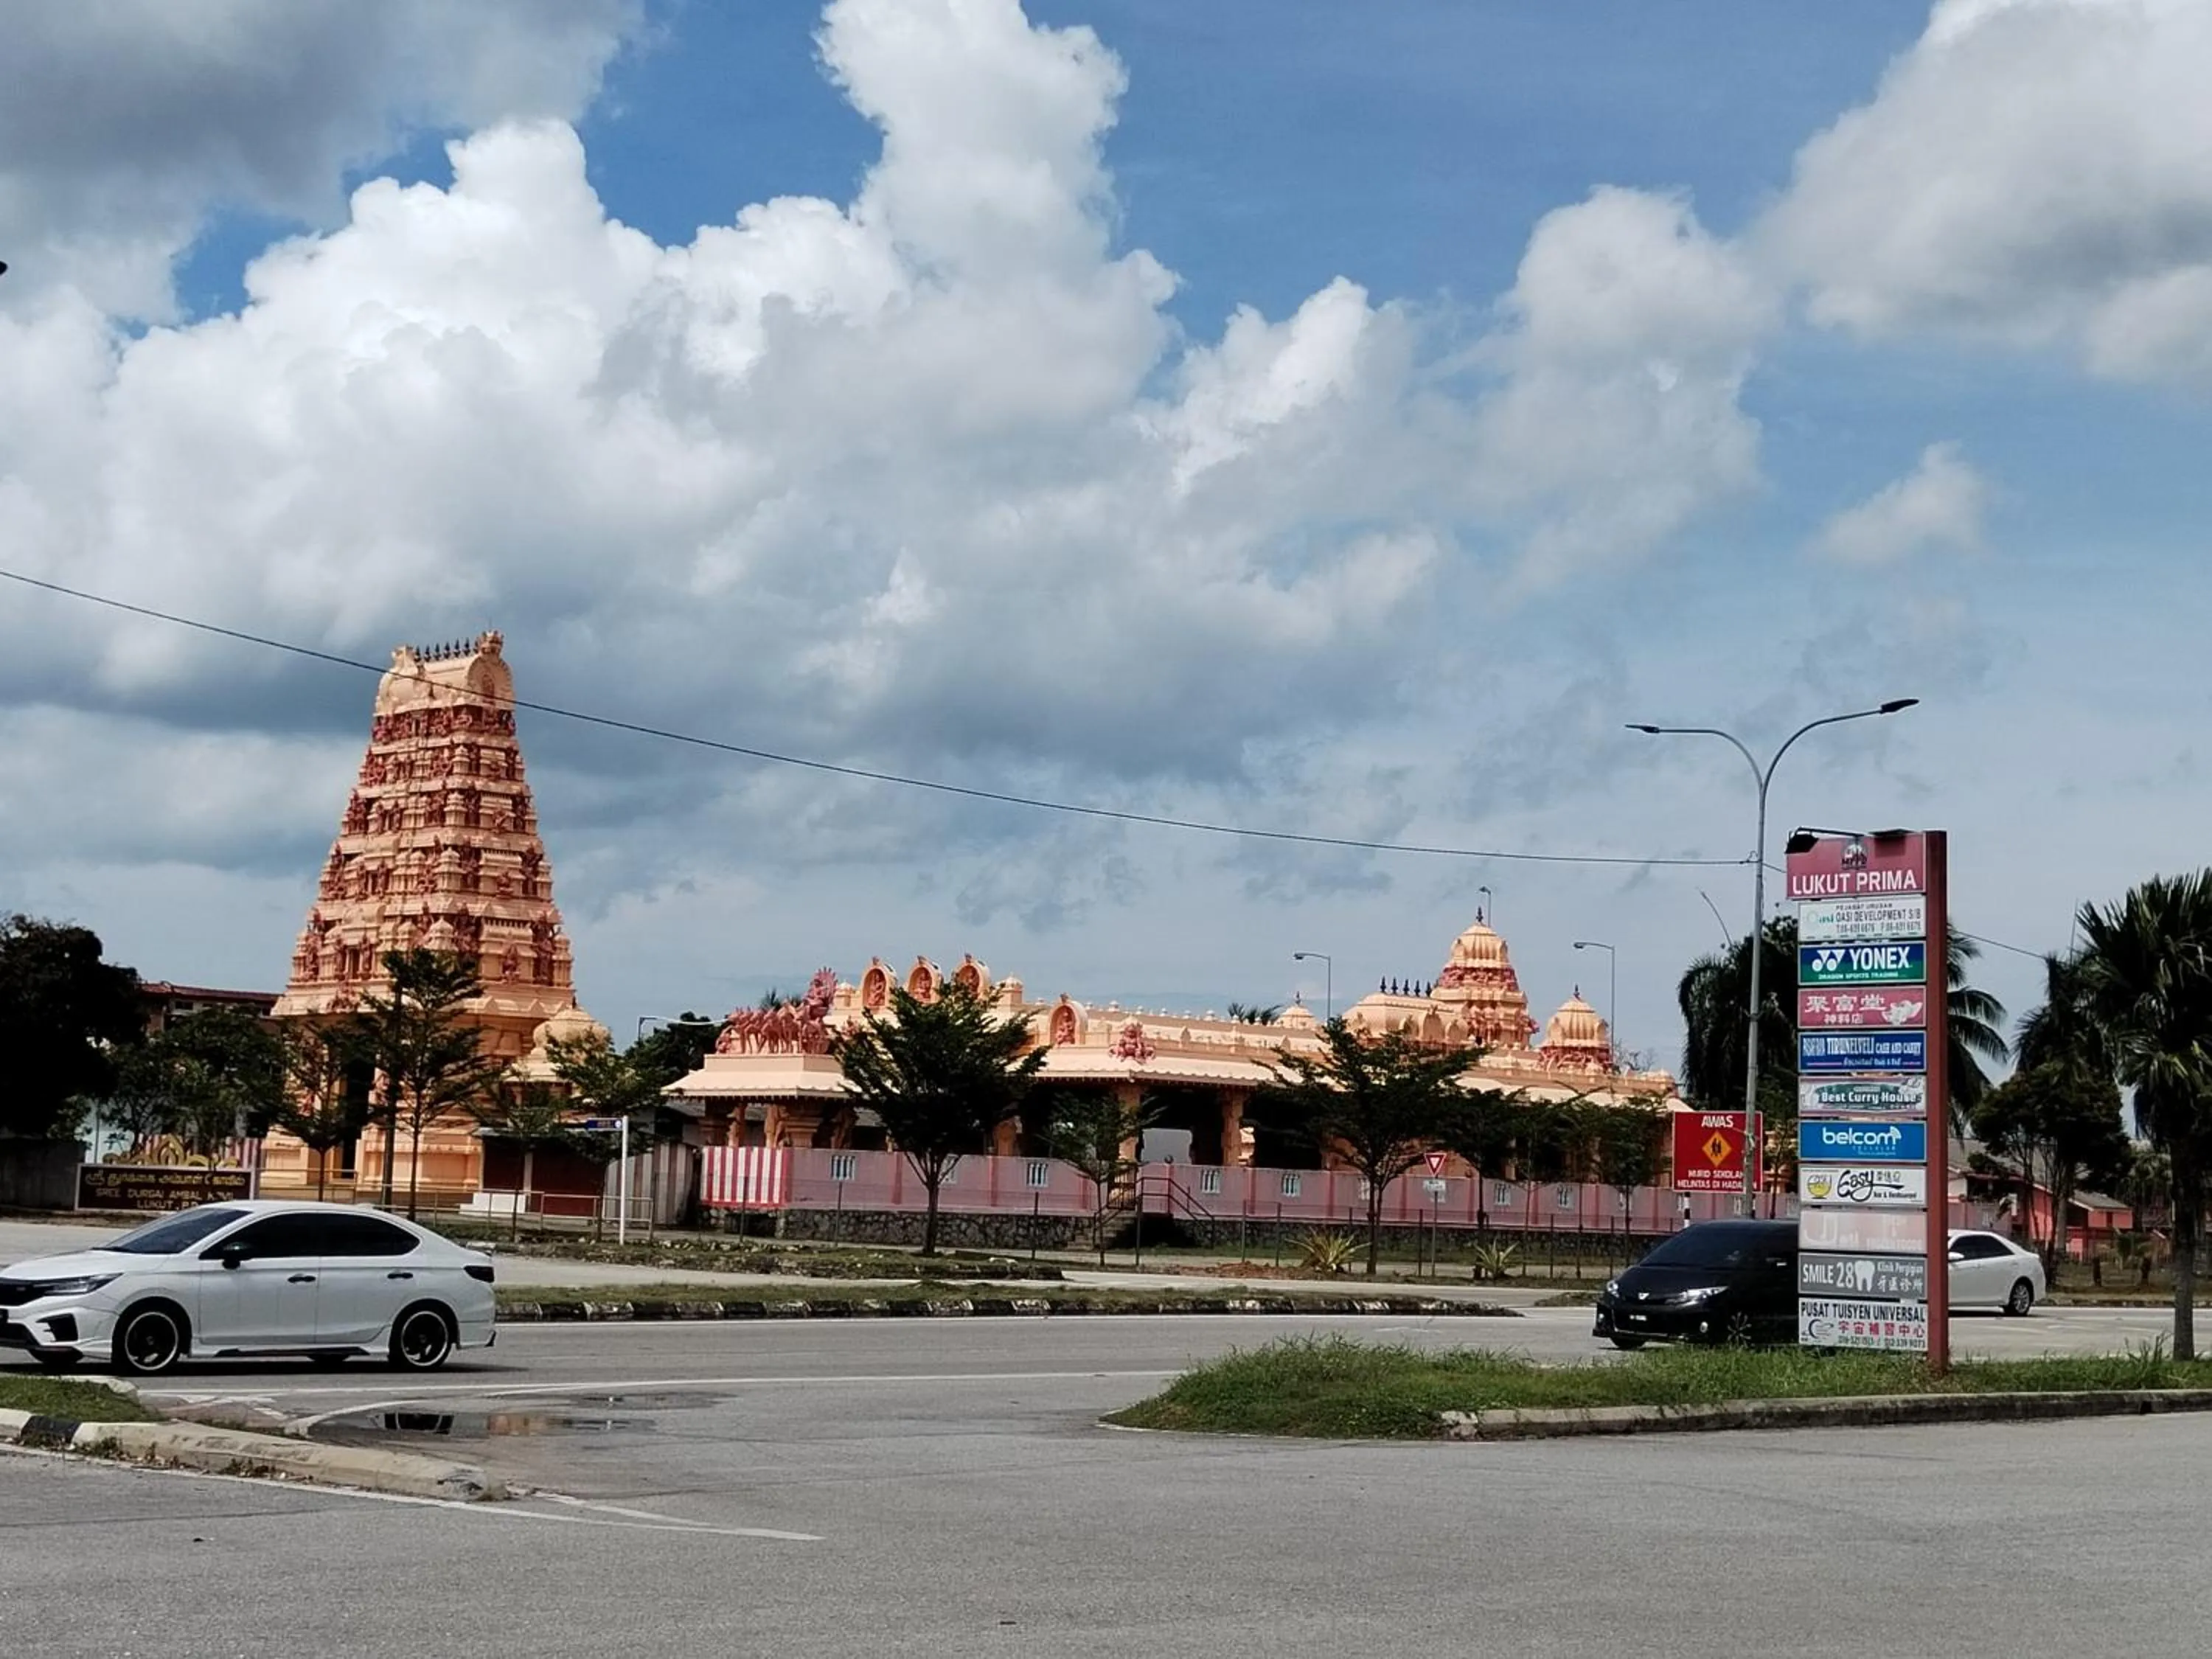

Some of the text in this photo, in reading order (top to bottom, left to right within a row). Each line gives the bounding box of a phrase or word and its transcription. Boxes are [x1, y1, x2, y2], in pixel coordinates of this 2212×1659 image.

[1792, 869, 1916, 894] LUKUT PRIMA
[1854, 909, 1906, 922] DEVELOPMENT
[1849, 946, 1910, 970] YONEX
[1821, 1092, 1846, 1102] Best
[1848, 1092, 1879, 1105] Curry
[1701, 1115, 1734, 1127] AWAS
[1822, 1126, 1899, 1145] belcom
[1688, 1169, 1711, 1178] MURID
[1677, 1180, 1711, 1189] MELINTAS
[1712, 1180, 1720, 1189] DI
[1837, 1169, 1882, 1202] Easy
[1803, 1262, 1855, 1288] SMILE 28
[1801, 1301, 1926, 1322] PUSAT TUISYEN UNIVERSAL
